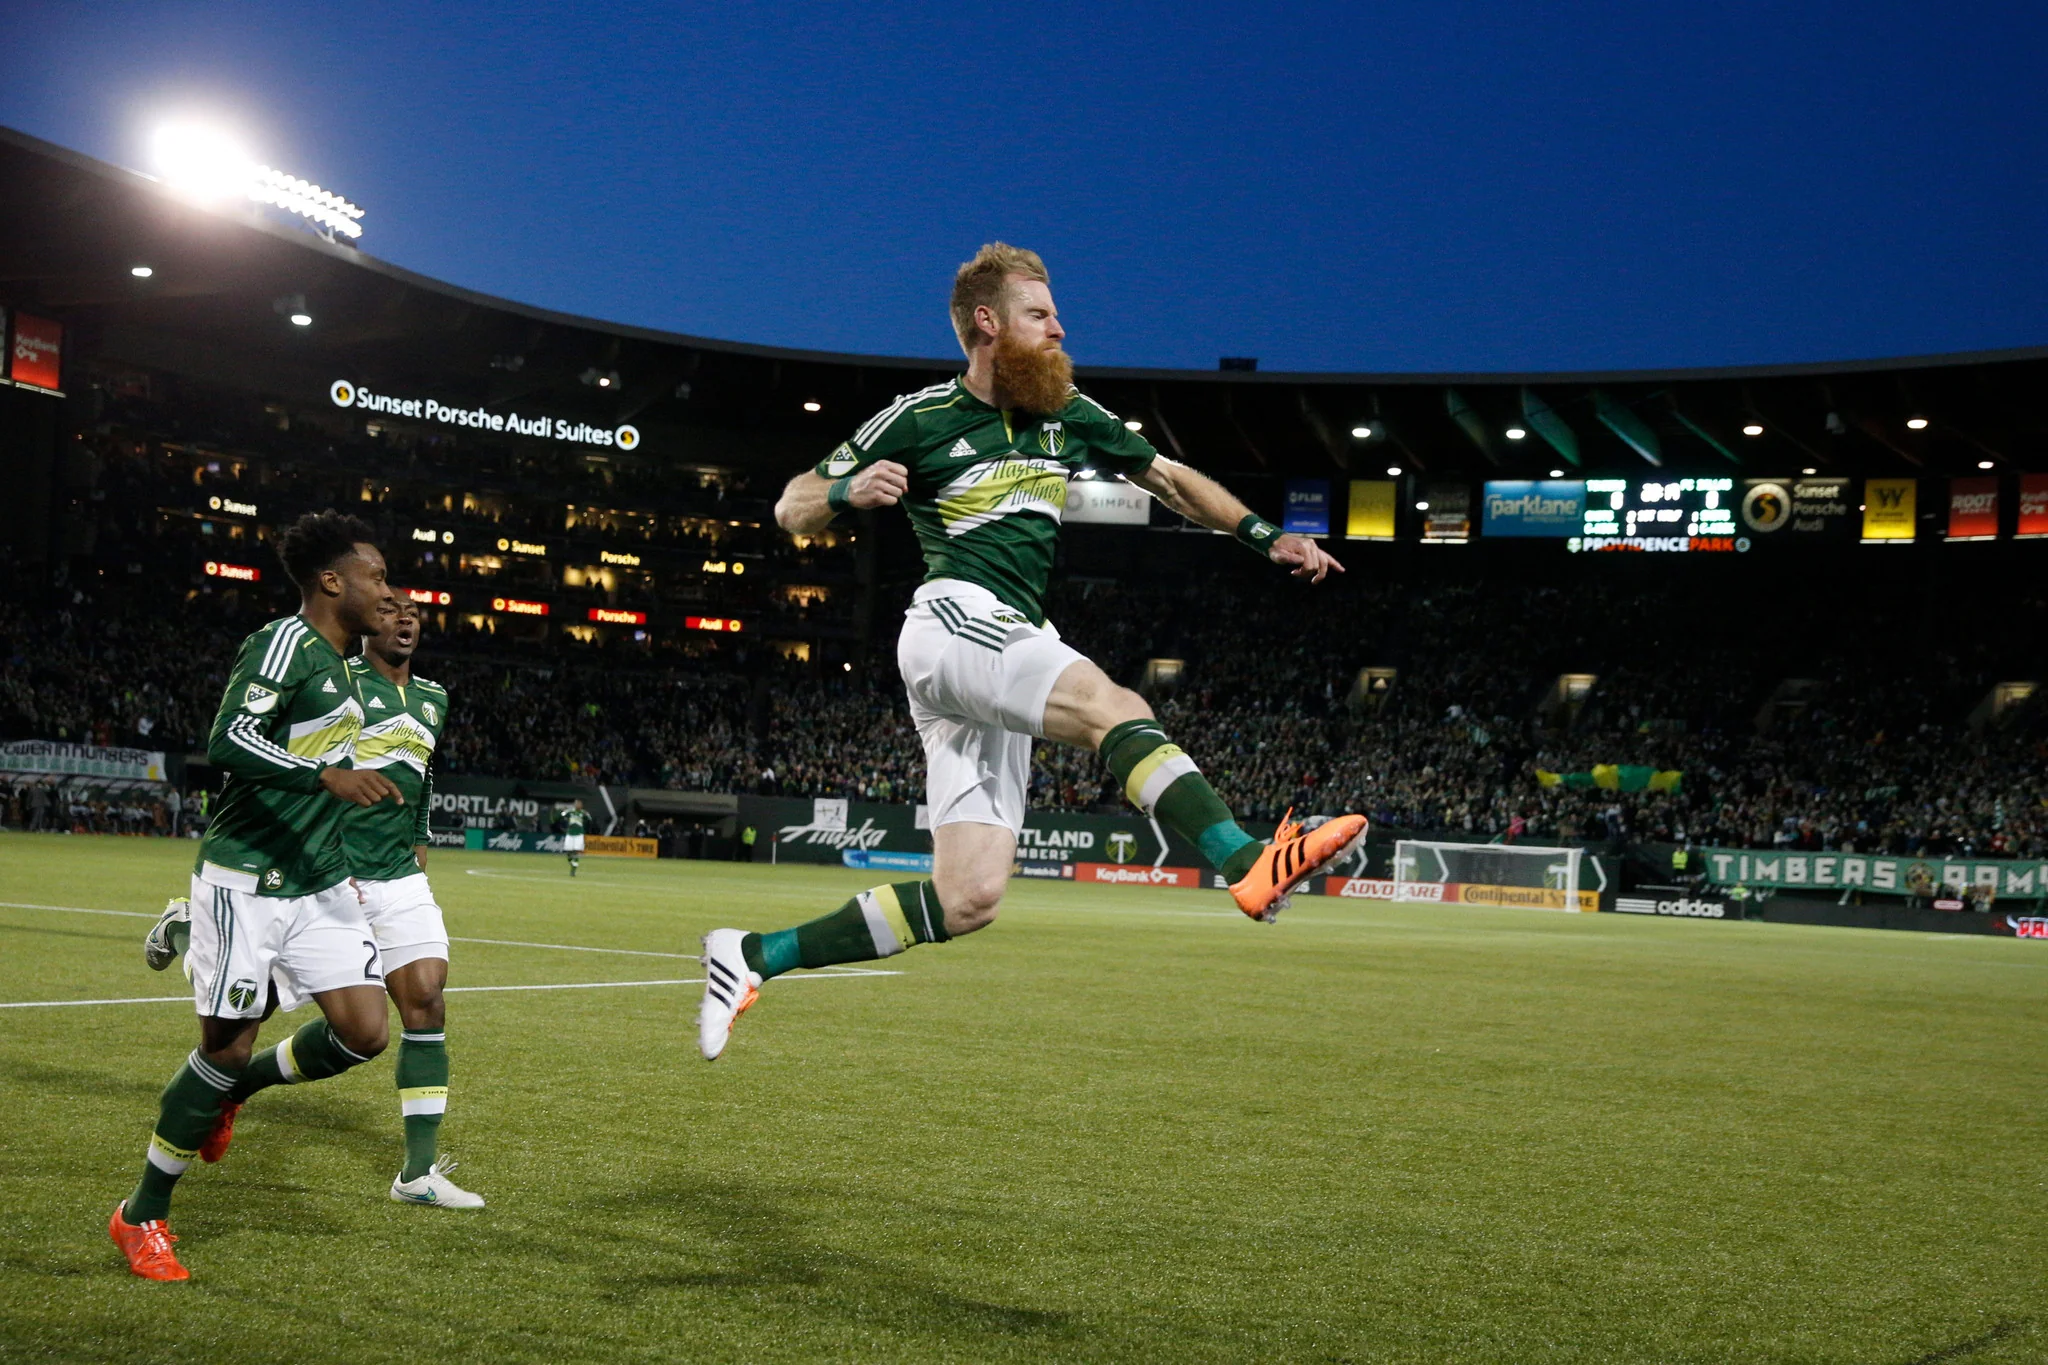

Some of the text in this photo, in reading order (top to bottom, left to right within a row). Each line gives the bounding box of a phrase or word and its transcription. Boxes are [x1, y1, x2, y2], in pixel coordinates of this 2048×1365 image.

[356, 386, 614, 446] Sunset Porsche Audi Suites
[949, 448, 977, 458] adidas
[965, 454, 1047, 485] Alaska
[988, 479, 1061, 511] Airlines
[1793, 483, 1841, 499] Sunset
[223, 498, 258, 517] Sunset
[1091, 498, 1142, 510] SIMPLE
[1792, 500, 1848, 516] Porsche
[412, 528, 437, 542] Audi
[511, 540, 546, 556] Sunset
[1583, 537, 1734, 551] PROVIDENCE PARK
[600, 550, 641, 566] Porsche
[219, 563, 254, 581] Sunset
[702, 560, 727, 574] Audi
[507, 599, 542, 615] Sunset
[596, 609, 637, 624] Porsche
[698, 617, 723, 631] Audi
[1021, 828, 1095, 849] TLAND
[1016, 847, 1069, 861] MBERS
[1096, 867, 1150, 883] KeyBank
[1712, 853, 1897, 889] TIMBERS
[1464, 885, 1544, 906] Continental
[1657, 898, 1725, 918] adidas
[362, 940, 383, 982] 2
